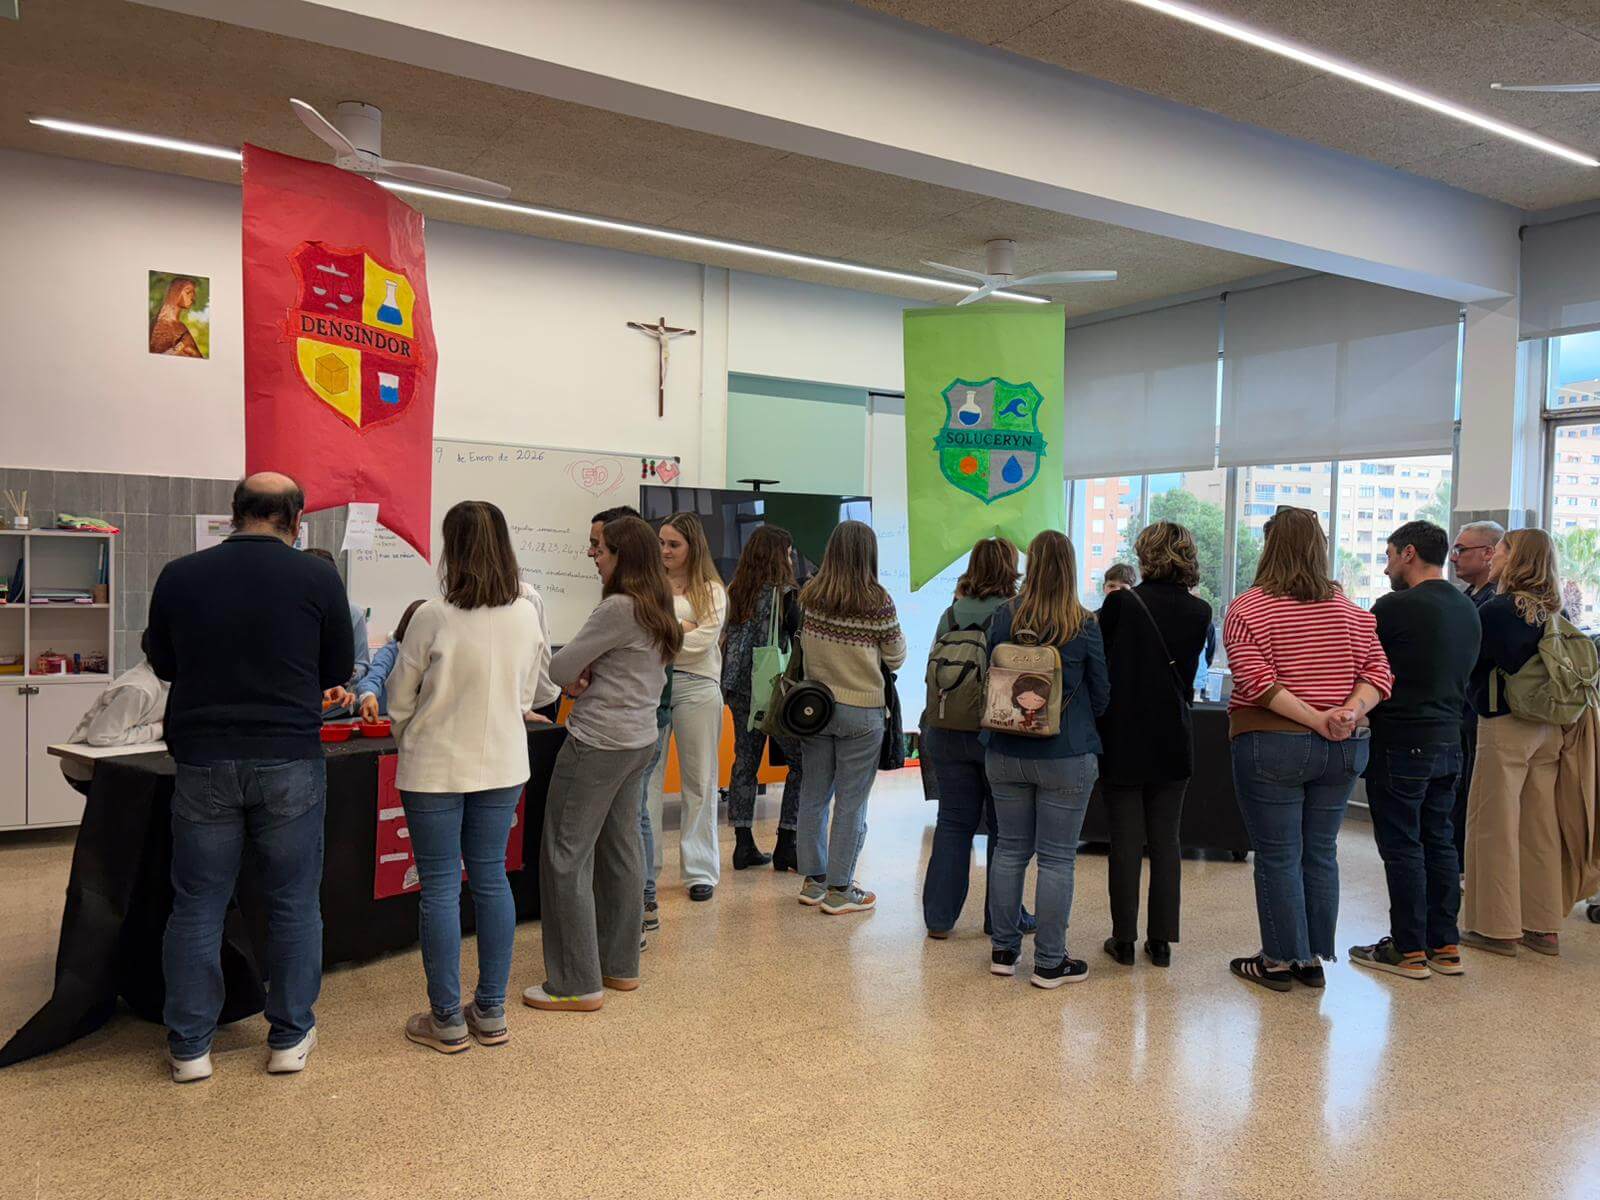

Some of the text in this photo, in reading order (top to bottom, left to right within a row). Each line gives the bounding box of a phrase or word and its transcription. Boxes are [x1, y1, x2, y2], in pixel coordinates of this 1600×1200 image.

[301, 315, 411, 357] DENSINDOR
[946, 432, 1033, 447] SOLUCERYN
[435, 446, 443, 464] 9
[469, 451, 494, 462] Enero
[498, 453, 508, 462] de
[516, 449, 545, 461] 2026
